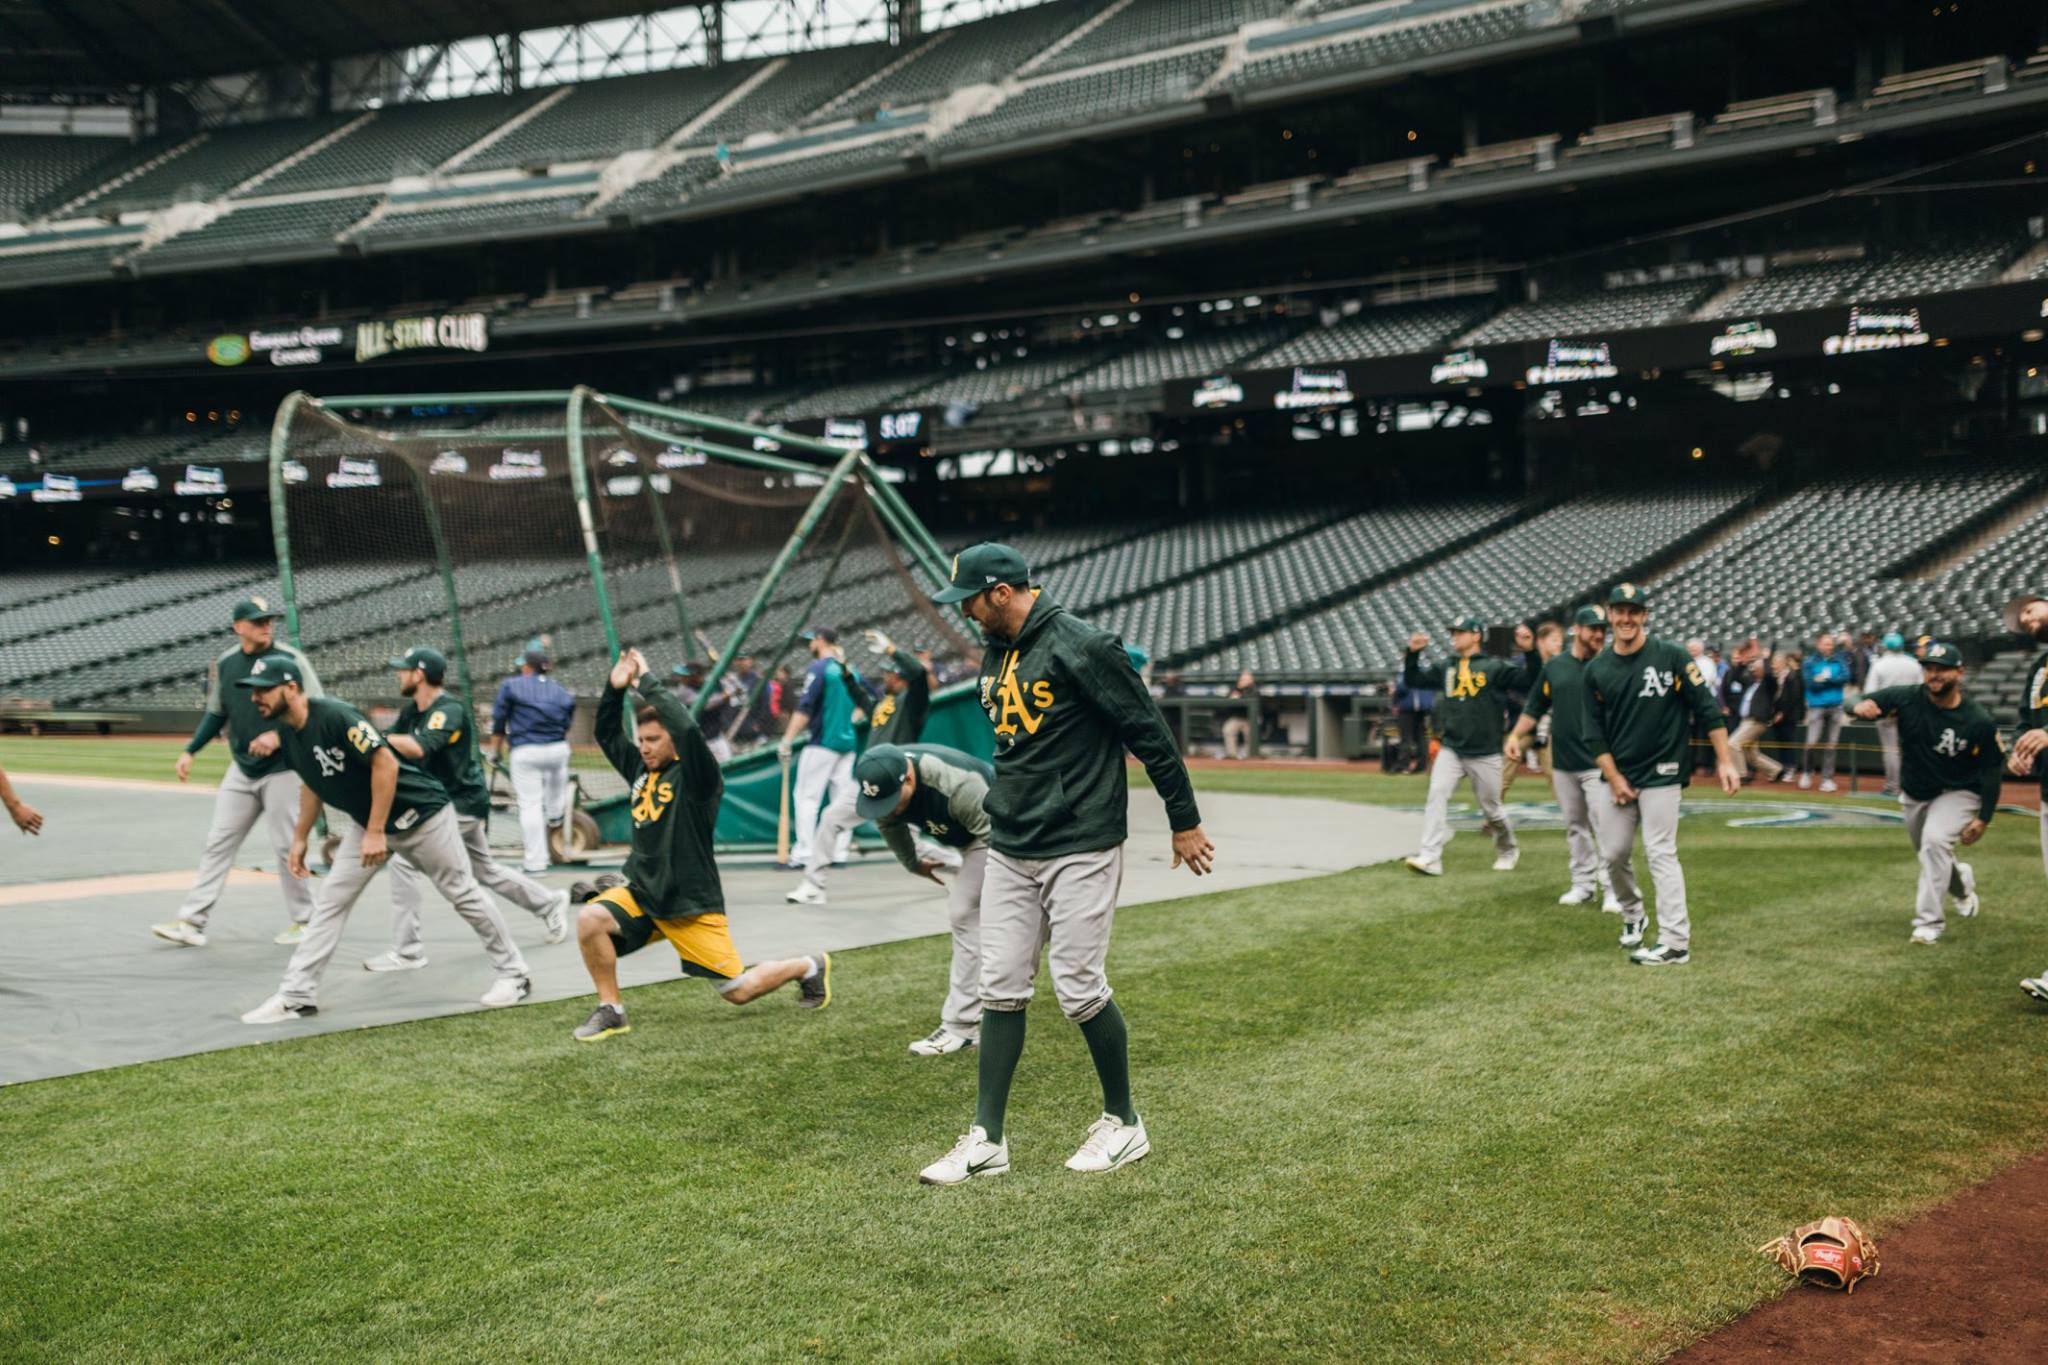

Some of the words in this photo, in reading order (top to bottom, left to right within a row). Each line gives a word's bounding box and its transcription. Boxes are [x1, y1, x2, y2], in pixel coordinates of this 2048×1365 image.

[438, 313, 488, 351] CLUB
[993, 650, 1055, 735] A's
[1638, 666, 1674, 697] A's
[312, 744, 345, 777] A's
